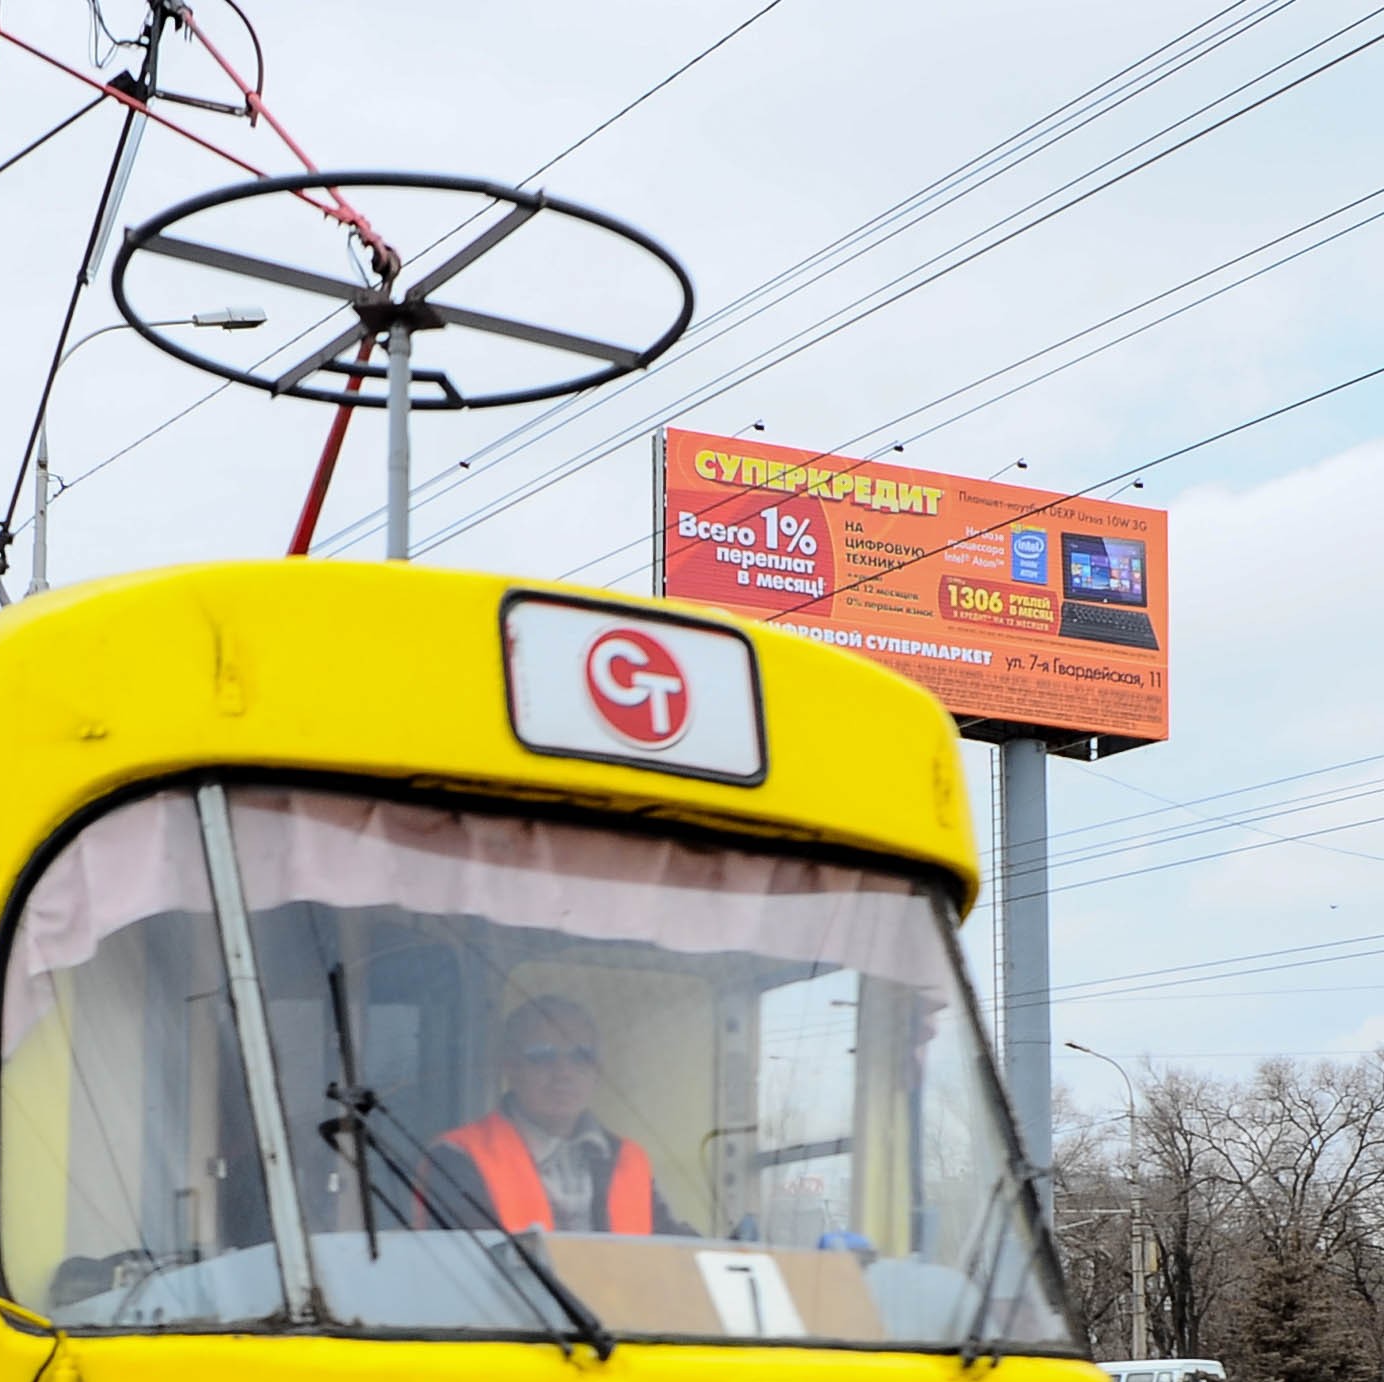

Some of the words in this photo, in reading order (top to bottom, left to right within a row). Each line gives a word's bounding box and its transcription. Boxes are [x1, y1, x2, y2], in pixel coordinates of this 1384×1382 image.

[695, 449, 943, 516] СУПЕРКРЕДИТ
[678, 511, 756, 546] Всего
[760, 506, 818, 555] 1%
[845, 520, 864, 533] НА
[716, 546, 815, 574] переплат
[845, 538, 925, 557] ЦИФРОВУЮ
[846, 553, 906, 571] ТЕХНИКУ
[737, 570, 751, 585] в
[947, 584, 1004, 614] 1306
[1009, 593, 1051, 609] РУБЛЕЙ
[1018, 606, 1054, 623] МЕСЯЦ
[866, 634, 993, 666] СУПЕРМАРКЕТ
[1005, 656, 1025, 672] ул.
[1029, 654, 1049, 673] 7-я
[1053, 658, 1144, 689] Гвардейская,
[1150, 671, 1161, 688] 11
